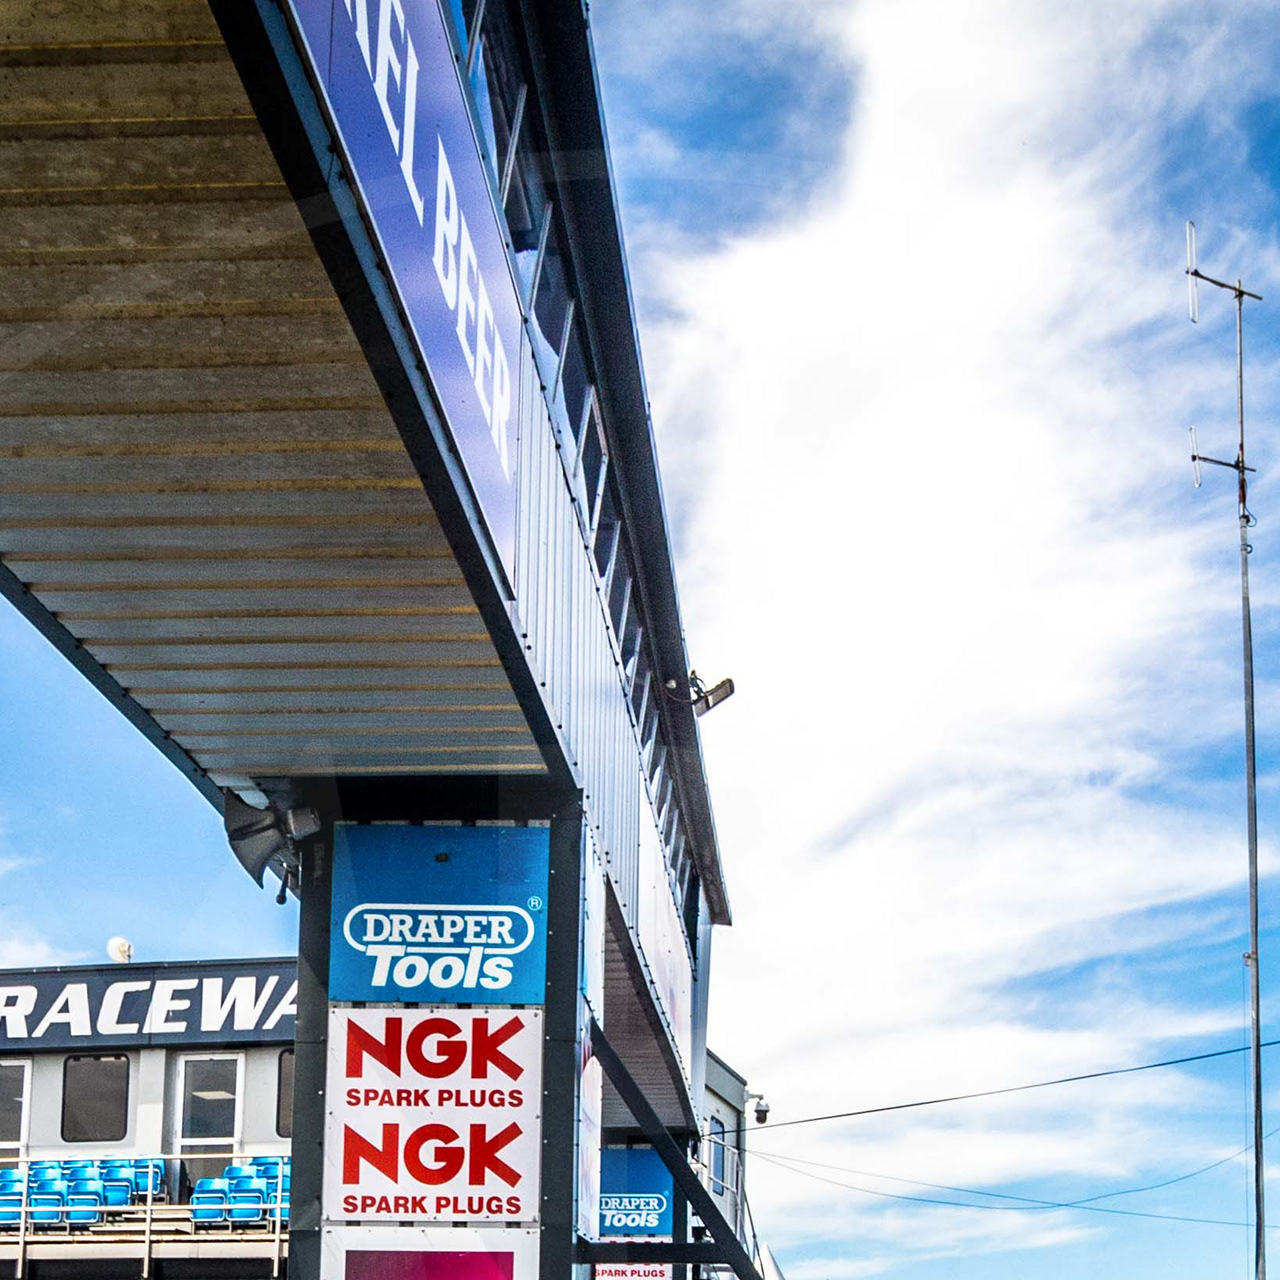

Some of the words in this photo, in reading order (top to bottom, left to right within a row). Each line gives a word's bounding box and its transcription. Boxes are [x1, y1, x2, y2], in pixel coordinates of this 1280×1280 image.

[432, 133, 510, 484] BEER
[362, 911, 515, 945] DRAPER
[366, 944, 513, 990] Tools
[345, 1016, 525, 1082] NGK
[346, 1088, 430, 1108] SPARK
[437, 1088, 524, 1108] PLUGS
[342, 1123, 523, 1188] NGK
[342, 1195, 427, 1214] SPARK
[435, 1195, 522, 1215] PLUGS
[600, 1197, 660, 1210] DRAPER
[603, 1210, 660, 1227] Tools
[595, 1269, 628, 1277] SPARK
[630, 1269, 665, 1278] PLUGS
